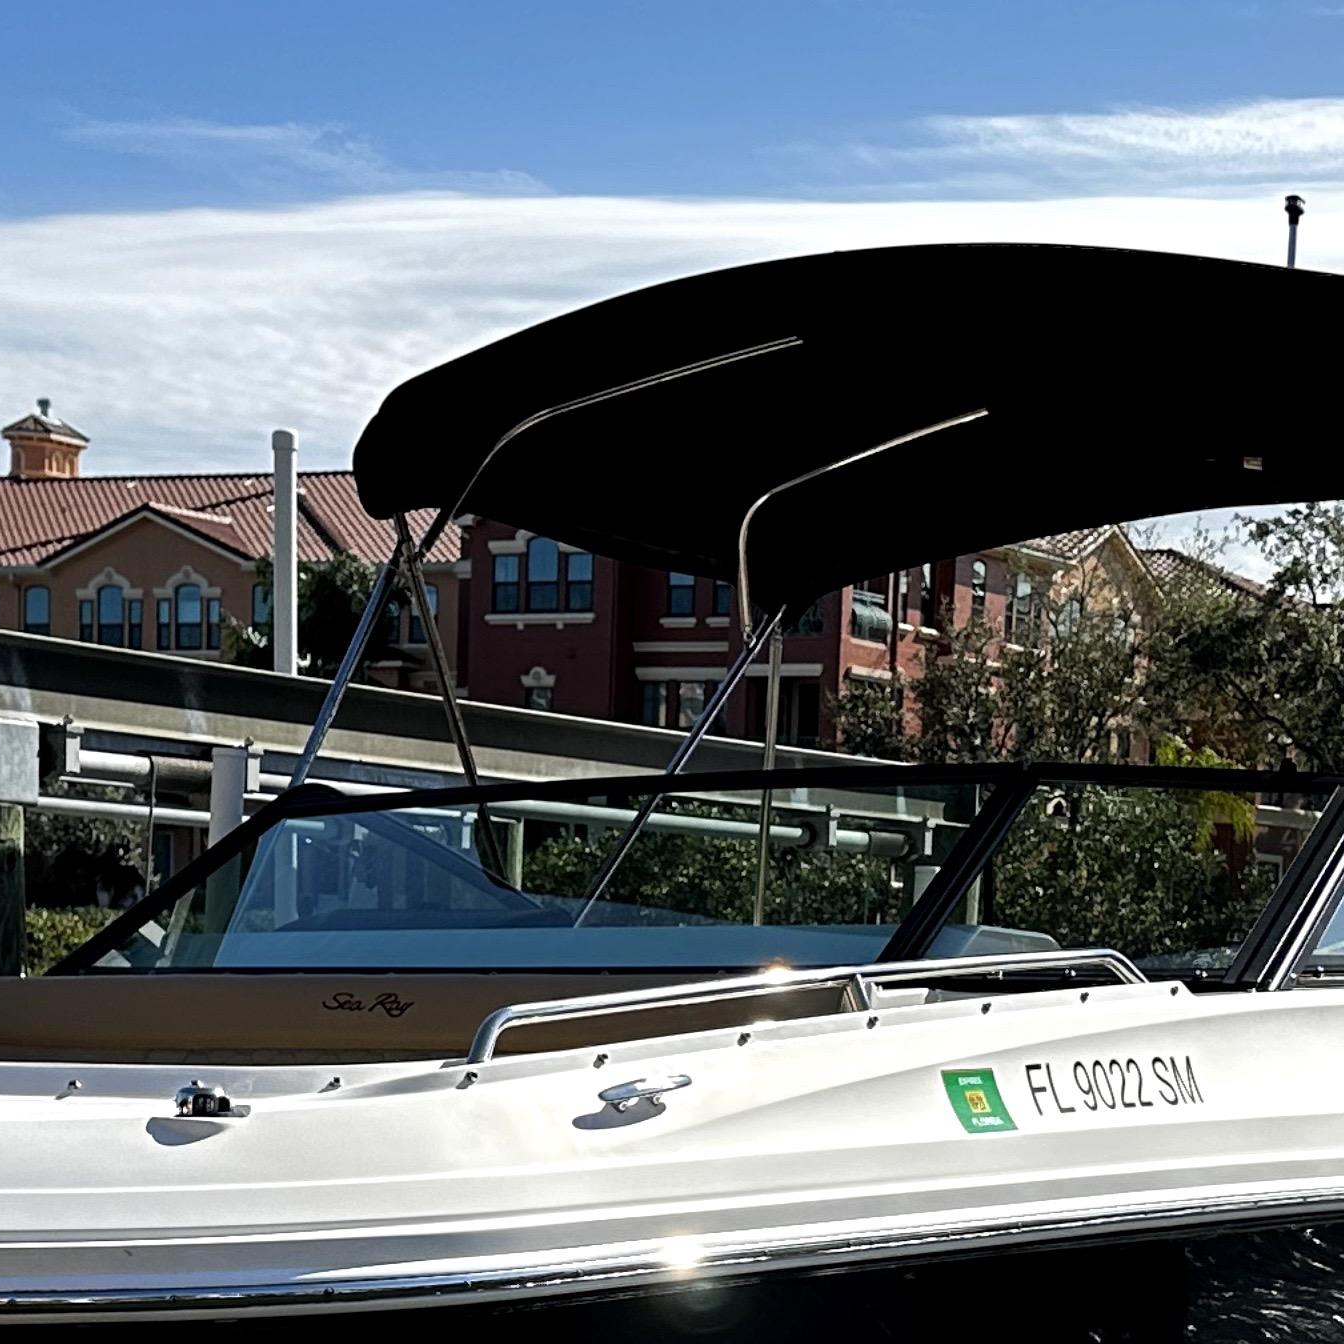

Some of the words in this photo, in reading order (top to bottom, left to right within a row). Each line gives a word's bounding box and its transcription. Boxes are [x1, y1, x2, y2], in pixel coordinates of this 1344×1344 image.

[322, 992, 365, 1012] Sea
[368, 993, 414, 1018] Ray
[1025, 1062, 1076, 1116] FL
[1072, 1058, 1154, 1111] 9022
[1151, 1055, 1204, 1105] SM
